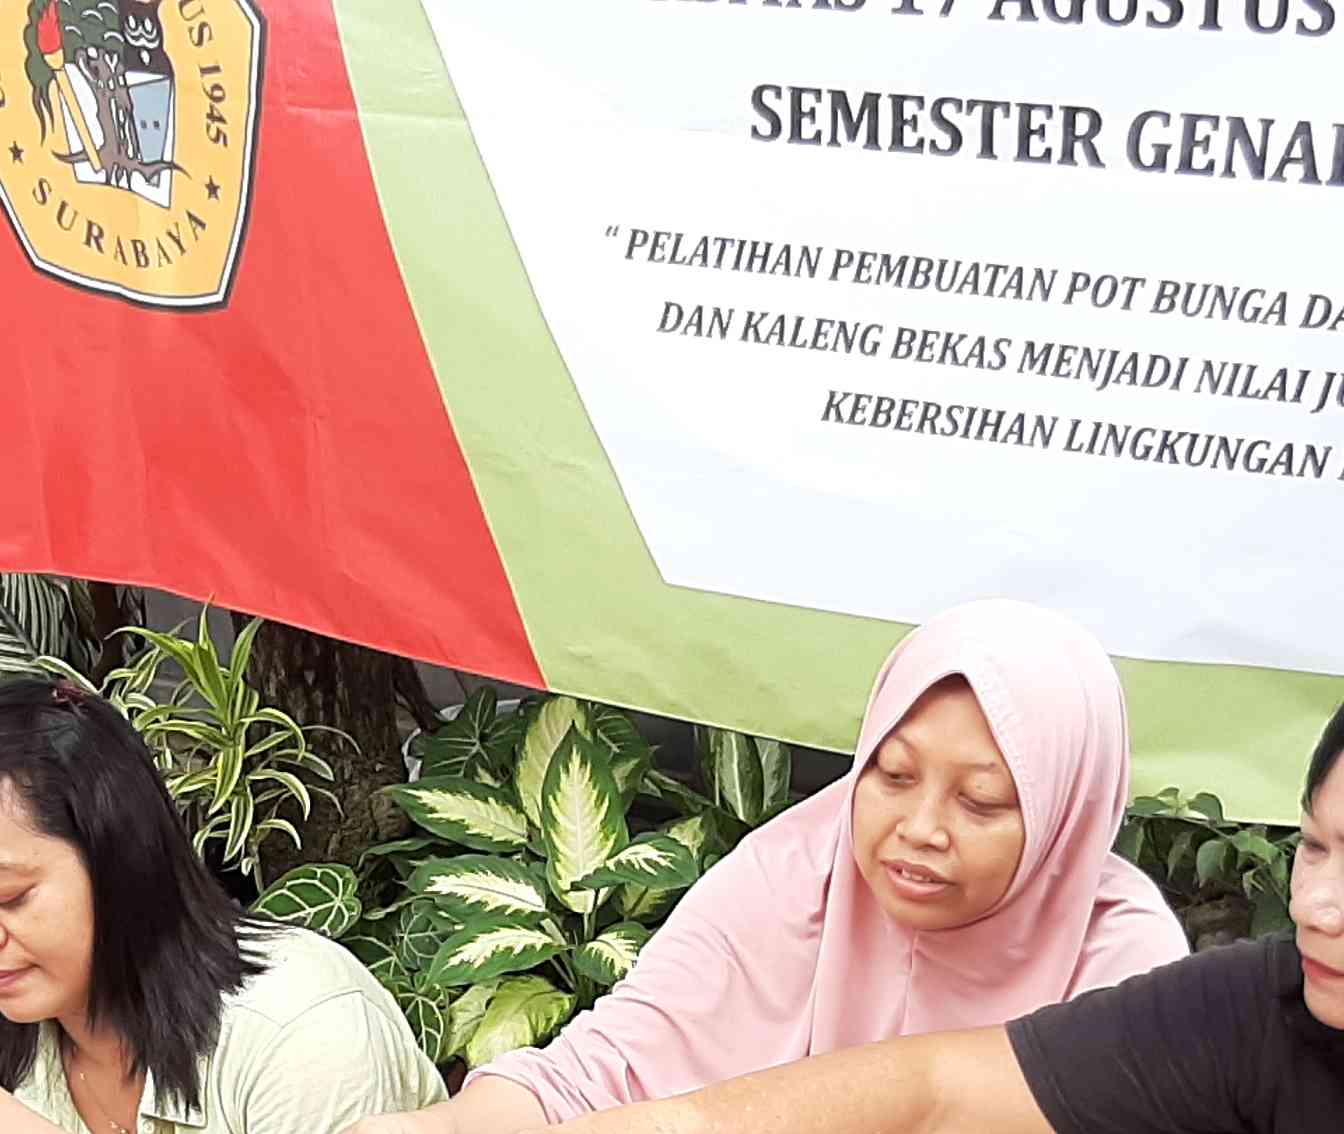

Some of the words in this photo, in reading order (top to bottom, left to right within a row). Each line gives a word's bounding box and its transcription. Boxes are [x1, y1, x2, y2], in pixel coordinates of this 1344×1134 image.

[198, 61, 228, 148] 1945
[751, 84, 1106, 168] SEMESTER
[32, 177, 207, 269] SURABAYA
[625, 228, 823, 278] PELATIHAN
[829, 249, 1058, 302] PEMBUATAN
[1063, 271, 1147, 310] POT
[1150, 280, 1288, 326] BUNGA
[658, 301, 735, 339] DAN
[741, 311, 884, 356] KALENG
[890, 327, 1012, 371] BEKAS
[1017, 340, 1189, 392] MENJADI
[1193, 359, 1311, 403] NILAI
[821, 390, 1059, 448] KEBERSIHAN
[1063, 419, 1333, 479] LINGKUNGAN
